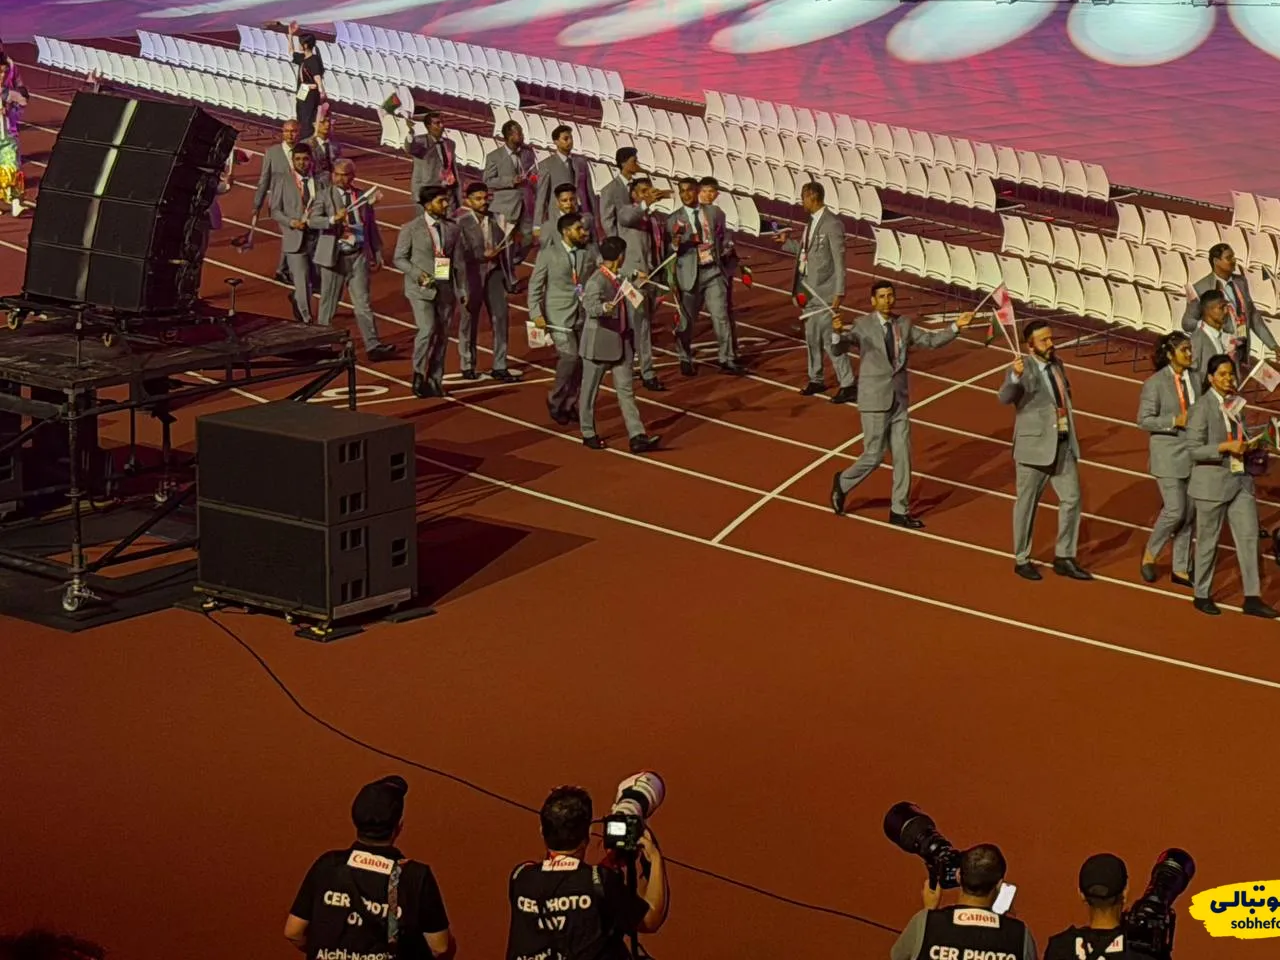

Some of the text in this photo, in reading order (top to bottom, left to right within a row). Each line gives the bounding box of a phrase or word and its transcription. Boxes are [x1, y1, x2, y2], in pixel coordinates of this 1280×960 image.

[353, 854, 389, 869] Canon
[324, 890, 350, 907] CER
[957, 912, 996, 924] Canon
[929, 945, 959, 960] CER
